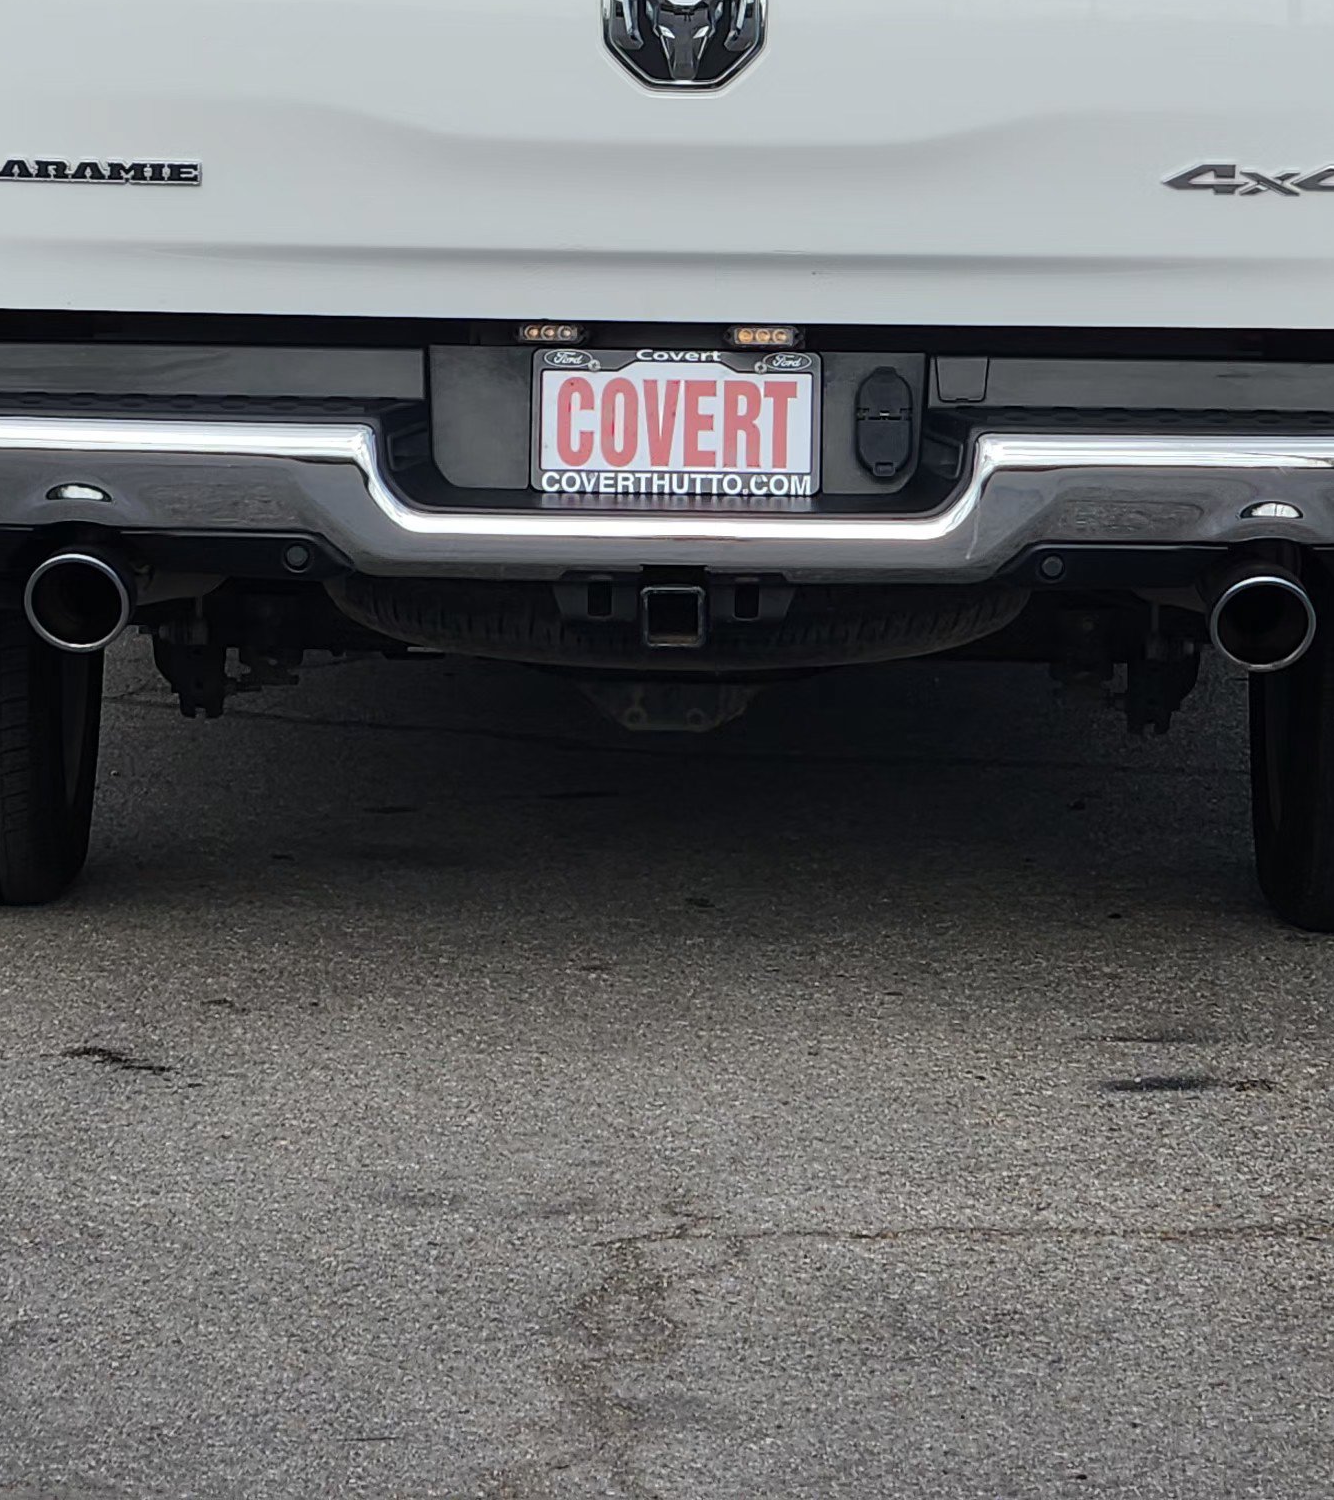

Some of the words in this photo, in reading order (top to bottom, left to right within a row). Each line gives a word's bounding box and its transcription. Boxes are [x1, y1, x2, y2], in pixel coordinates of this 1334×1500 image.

[552, 351, 583, 366] Ford
[636, 349, 722, 362] Covert
[772, 354, 803, 368] Ford
[556, 376, 798, 469] COVERT
[541, 472, 812, 495] COVERTHUTTO.COM
